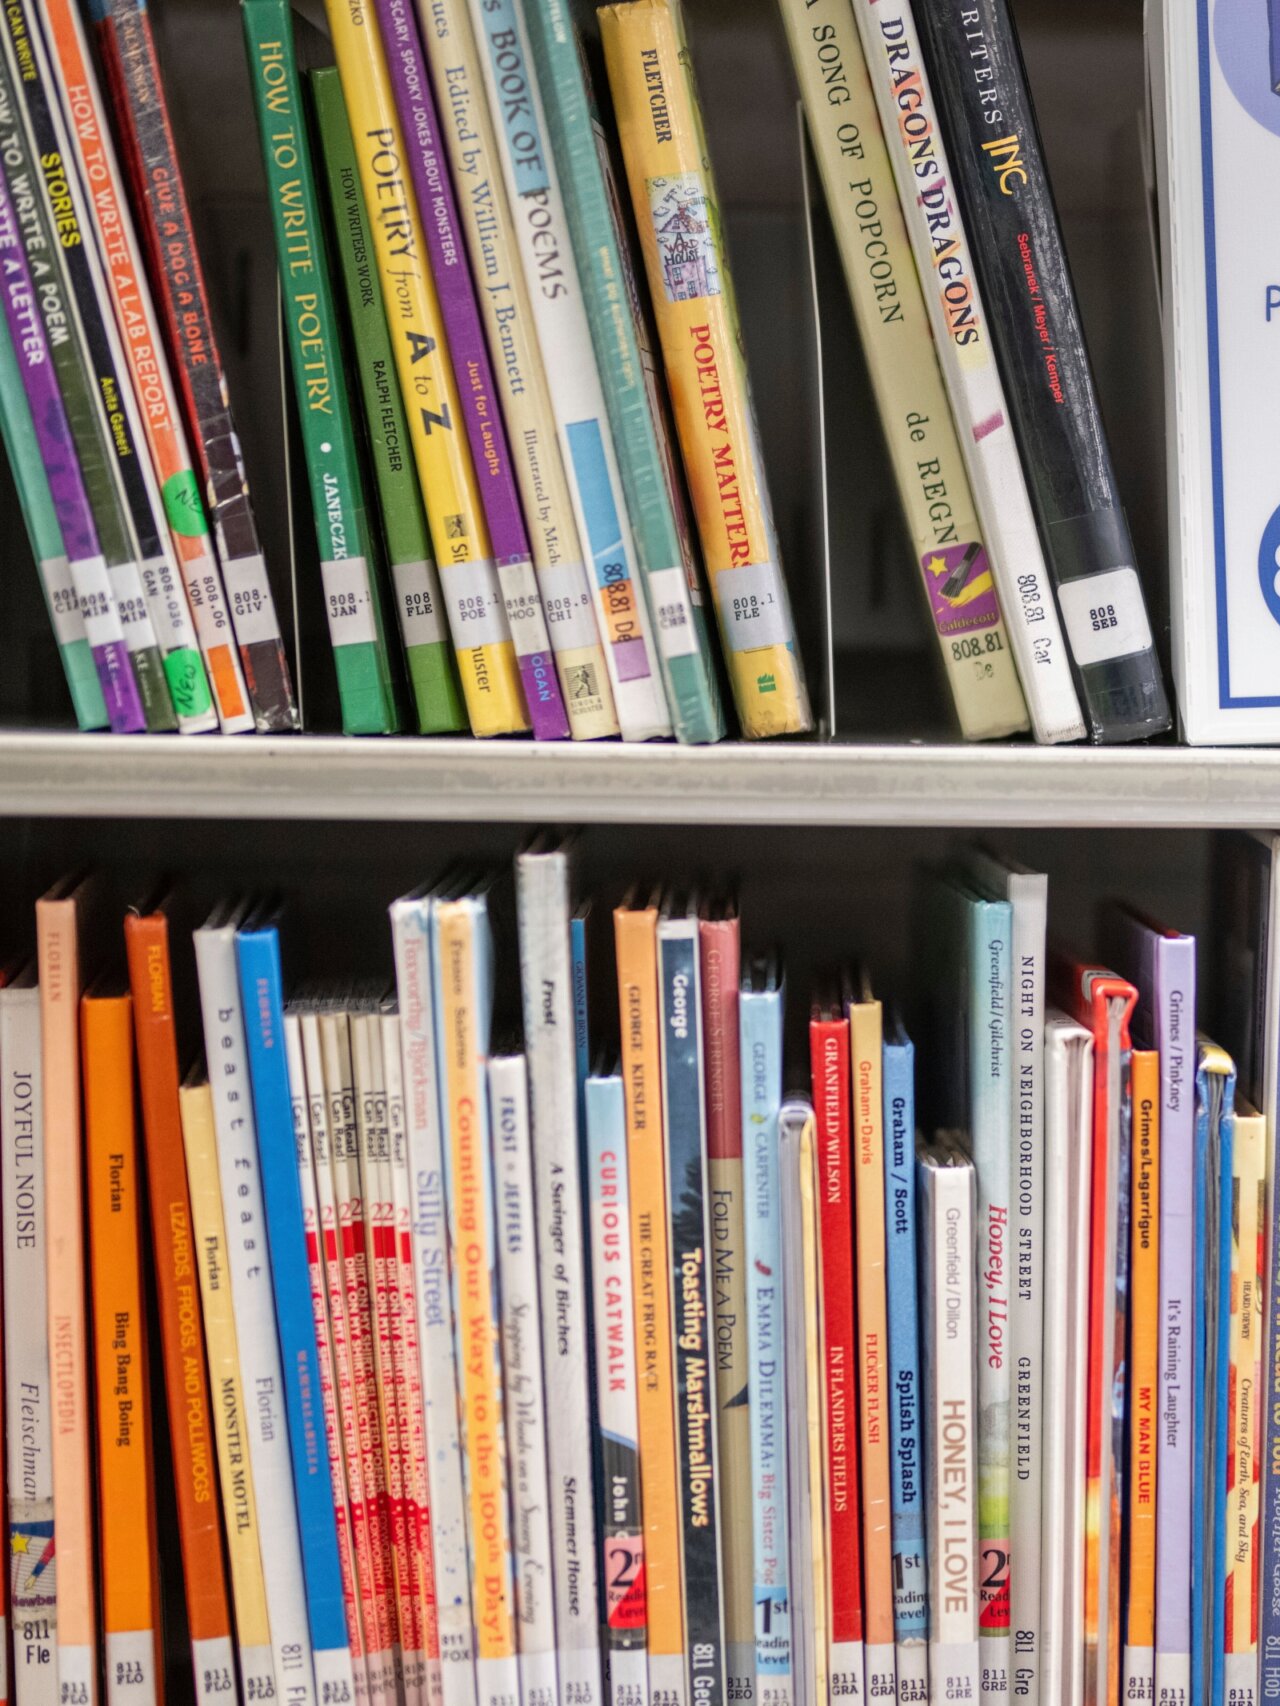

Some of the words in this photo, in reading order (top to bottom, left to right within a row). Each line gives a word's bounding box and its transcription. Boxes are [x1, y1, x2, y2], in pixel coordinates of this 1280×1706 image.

[260, 42, 289, 114] HOW
[641, 48, 672, 144] FLETCHER
[813, 24, 851, 107] SONG
[69, 85, 97, 141] HOW
[837, 124, 864, 160] OF
[85, 149, 106, 181] TO
[272, 126, 297, 169] TO
[492, 28, 530, 123] BOOK
[511, 131, 542, 172] OF
[527, 191, 568, 300] POEMS
[981, 135, 1027, 195] INC
[42, 153, 81, 248] STORIES
[368, 128, 418, 259] POETRY
[880, 16, 938, 179] DRAGONS
[921, 189, 979, 346] DRAGONS
[95, 187, 129, 265] WRITE
[279, 180, 314, 278] WRITE
[850, 177, 904, 324] POPCORN
[115, 274, 133, 288] A
[386, 269, 421, 318] from
[120, 298, 145, 340] LAB
[406, 331, 436, 365] A
[1017, 232, 1038, 294] Sebranek
[1033, 305, 1050, 344] Meyer
[1046, 354, 1064, 404] Kemper
[295, 294, 333, 416] POETRY
[373, 360, 391, 406] RALPH
[414, 376, 428, 396] to
[689, 324, 730, 434] POETRY
[133, 345, 173, 431] REPORT
[421, 403, 452, 436] Z
[381, 407, 402, 472] FLETCHER
[906, 412, 929, 443] de
[405, 593, 430, 605] 808
[407, 604, 433, 617] FLE
[602, 563, 631, 616] 808.81
[1018, 574, 1045, 626] 808.81
[1089, 605, 1115, 620] 808
[952, 631, 1003, 662] 808.81
[1092, 618, 1118, 631] SEB
[670, 974, 688, 1038] George
[1022, 957, 1034, 1016] NIGHT
[1022, 1029, 1033, 1051] ON
[13, 1072, 33, 1165] JOYFUL
[823, 1038, 841, 1203] GRANFIELD/WILSON
[893, 1097, 906, 1167] Graham
[1020, 1065, 1033, 1216] NEIGHBORHOOD
[110, 1154, 124, 1212] Florian
[1139, 1100, 1153, 1248] Grimes/Lagarrigue
[16, 1174, 35, 1249] NOISE
[599, 1151, 619, 1266] CURIOUS
[895, 1189, 908, 1234] Scott
[1019, 1229, 1031, 1300] STREET
[681, 1247, 700, 1350] Toasting
[604, 1276, 625, 1392] CATWALK
[899, 1371, 913, 1433] Splish
[1139, 1388, 1151, 1413] MY
[685, 1358, 711, 1528] Marshmallows
[943, 1400, 966, 1508] HONEY,
[1139, 1419, 1151, 1455] MAN
[902, 1437, 916, 1503] Splash
[1139, 1460, 1151, 1503] BLUE
[944, 1537, 967, 1613] LOVE
[1015, 1630, 1034, 1654] 811
[1015, 1669, 1033, 1695] Gre
